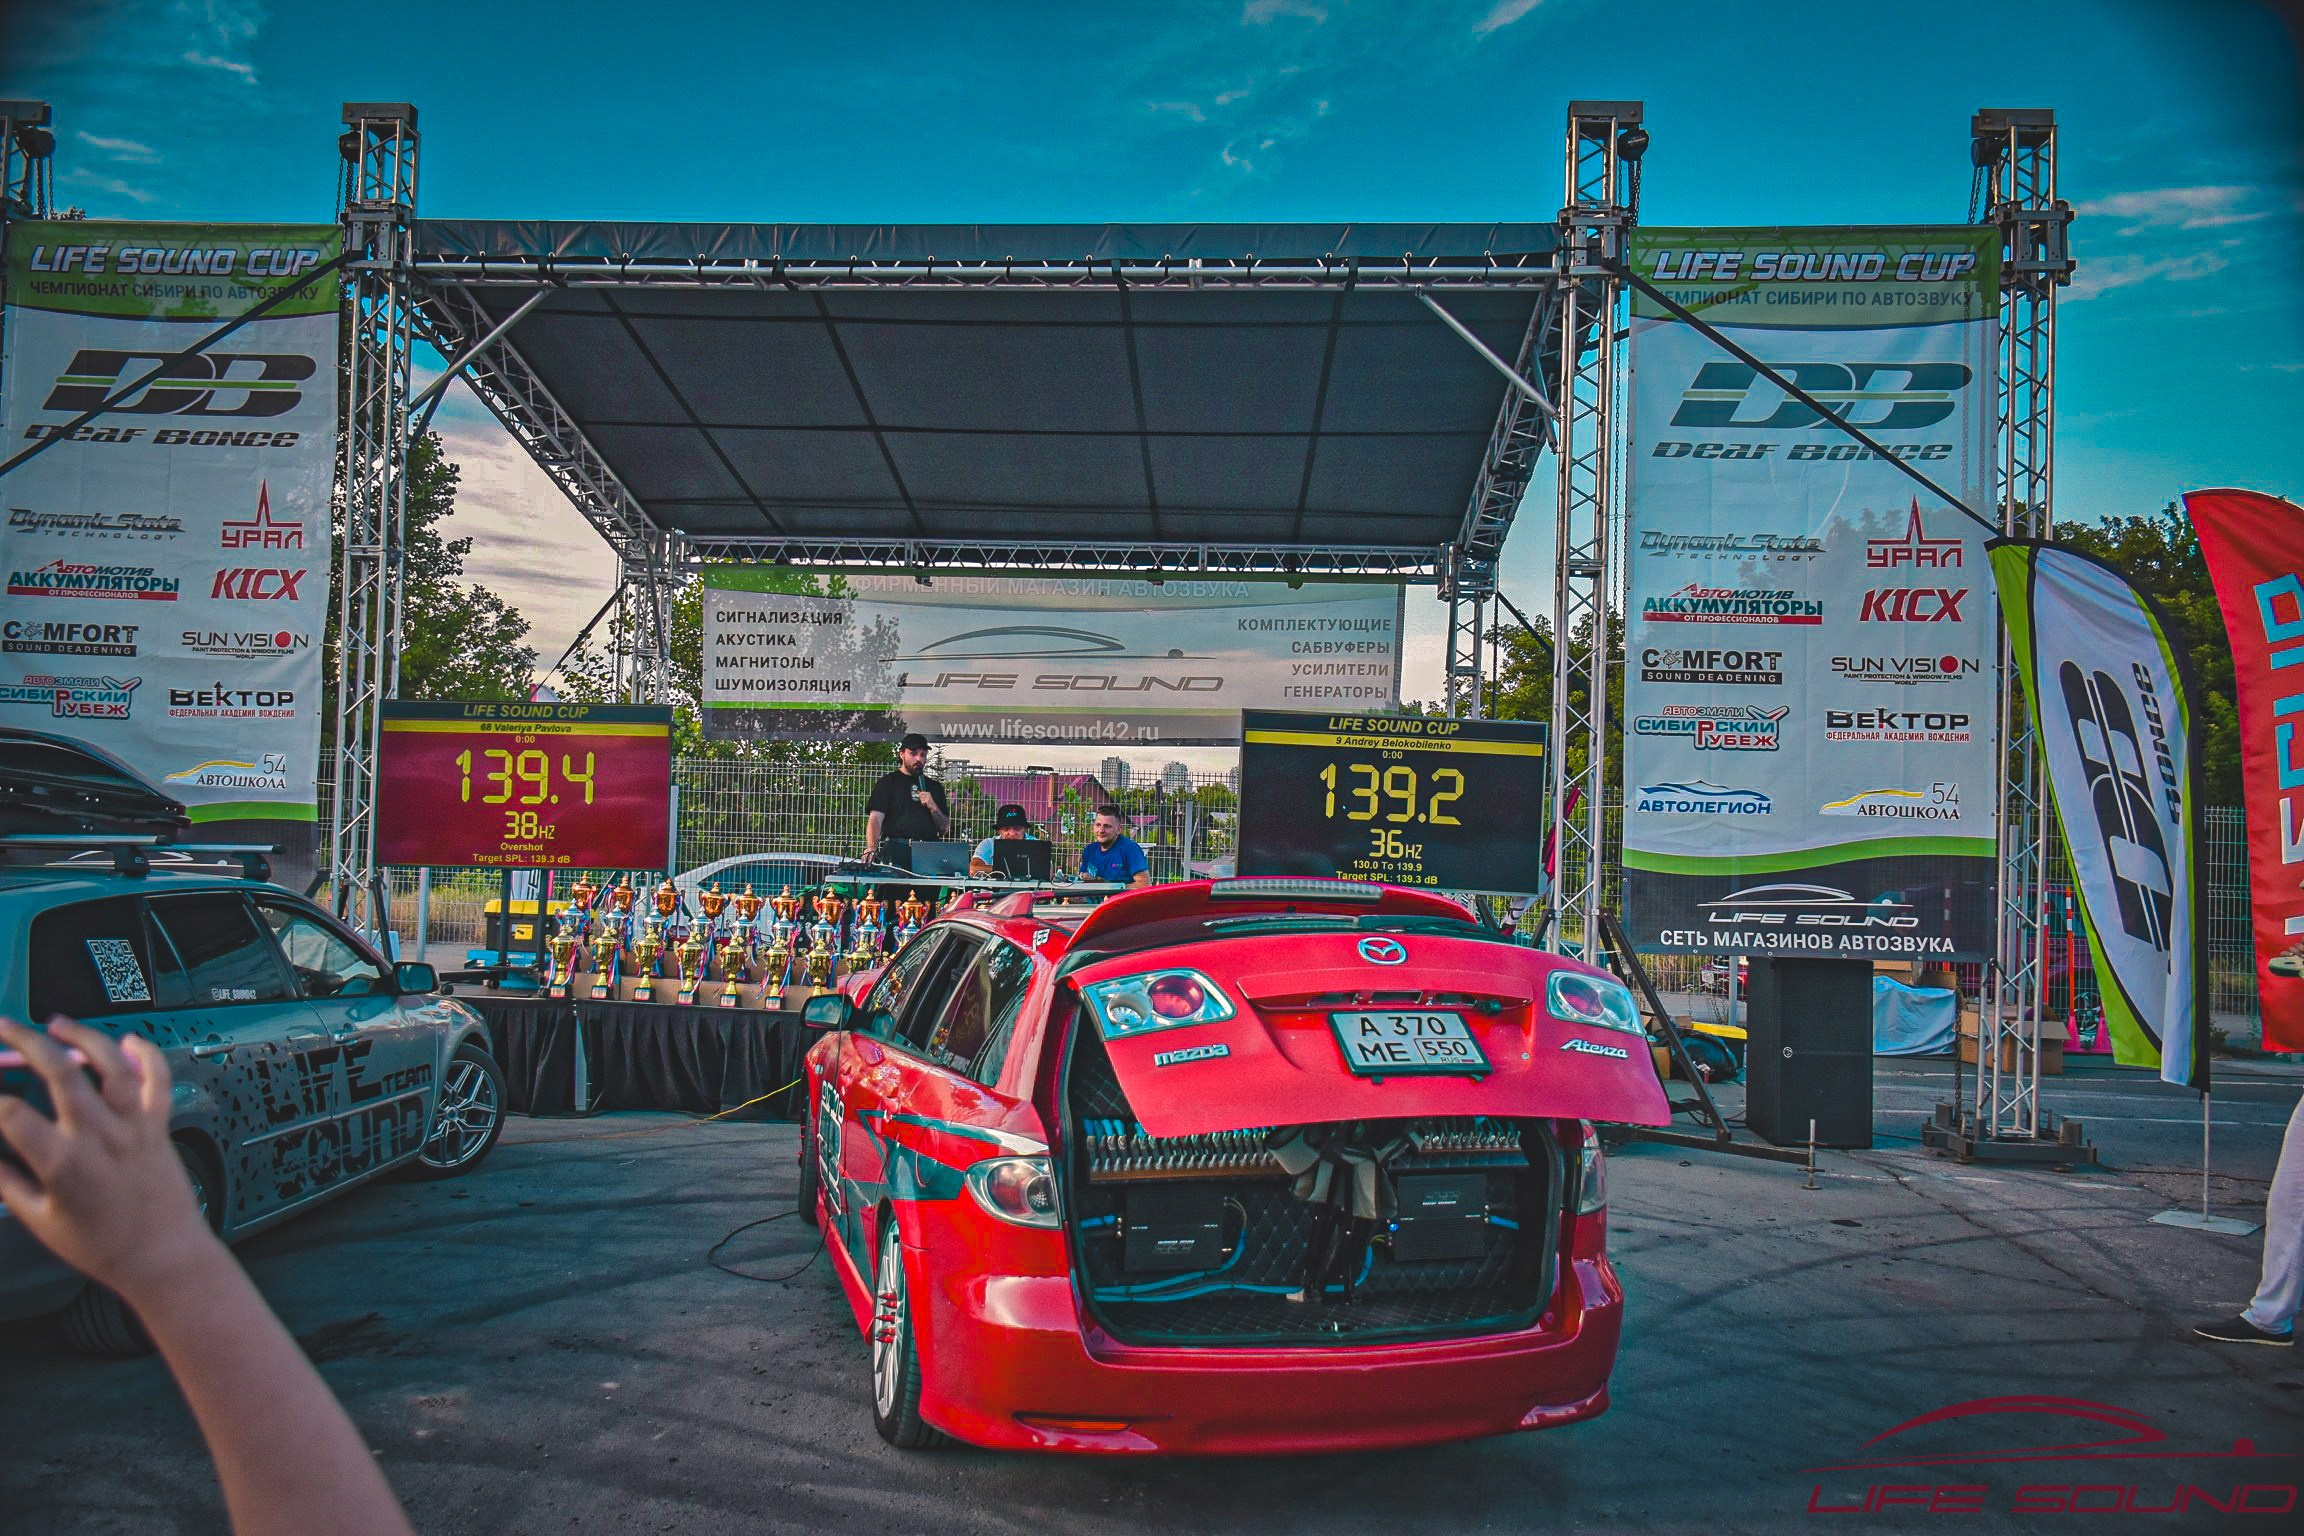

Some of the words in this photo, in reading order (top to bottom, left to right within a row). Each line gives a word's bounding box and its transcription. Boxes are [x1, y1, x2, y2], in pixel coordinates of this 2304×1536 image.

[30, 246, 110, 273] LIFE
[116, 248, 237, 276] SOUND
[246, 249, 320, 277] CUP
[1652, 251, 1743, 281] LIFE
[1749, 252, 1886, 281] SOUND
[1896, 252, 1977, 282] CUP
[30, 281, 128, 297] ЧЕМПИОНАТ
[133, 284, 196, 298] СИБИРИ
[201, 285, 223, 299] ПО
[228, 285, 319, 300] АВТОЗКУ
[1660, 291, 1761, 305] ЕМПИОНАТ
[1766, 291, 1836, 305] СИБИРИ
[1843, 291, 1866, 305] ПО
[9, 508, 112, 533] Dynamic
[117, 513, 186, 532] State
[44, 530, 176, 540] TECHNOLOGY
[222, 529, 303, 549] УРАЛ
[1640, 530, 1746, 557] Dynamic
[1751, 534, 1826, 553] State
[1676, 553, 1816, 561] TECHNOLOGY
[1867, 547, 1962, 568] УРАЛ
[8, 572, 179, 592] АККУМУЛЯТОРЫ
[210, 568, 307, 600] KICX
[1008, 579, 1111, 596] МАГАЗИН
[1118, 581, 1249, 598] АВТОЗВУКА
[49, 589, 60, 597] ОТ
[61, 590, 139, 599] ПРОФЕССИОНАЛОВ
[1643, 597, 1823, 615] АККУМУЛЯТОРЫ
[1859, 588, 1968, 622] KICX
[715, 611, 843, 626] СИГНАЛИЗАЦИЯ
[1238, 618, 1391, 633] КОМПЛЕКТУЮЩИЕ
[1697, 615, 1779, 623] ПРОФЕССИОНАЛОВ
[182, 631, 228, 646] SUN
[234, 631, 309, 648] VISION
[715, 633, 797, 647] АКУСТИКА
[8, 643, 51, 652] SOUND
[58, 645, 131, 655] DEADENING
[1292, 641, 1390, 655] САБВУФЕРЫ
[715, 656, 815, 670] МАГНИТОЛЫ
[1292, 663, 1389, 677] УСИЛИТЕЛИ
[1831, 657, 1884, 673] SUN
[1891, 656, 1979, 674] VISION
[23, 675, 100, 687] АВТОЭМАЛИ
[897, 673, 1019, 690] LIFE
[1031, 675, 1224, 692] SOUND
[1647, 672, 1691, 681] SOUND
[1698, 673, 1776, 682] DEADENING
[715, 679, 851, 693] ШУМОИЗОЛЯЦИЯ
[1283, 686, 1388, 699] ГЕНЕРАТОРЫ
[169, 709, 217, 717] ФЕДЕРАЛЬНАЯ
[221, 709, 255, 717] АКАДЕМИЯ
[259, 709, 294, 718] ВОЖДЕНИЯ
[463, 704, 495, 717] LIFE
[500, 705, 552, 718] SOUND
[557, 706, 589, 718] CUP
[1663, 705, 1744, 717] АВТОЭМАЛИ
[481, 723, 492, 732] 68
[494, 723, 532, 734] Valeriya
[534, 724, 572, 733] Pavlova
[940, 719, 1159, 742] www.lifesound42.ru
[1329, 717, 1362, 731] LIFE
[1366, 719, 1422, 734] SOUND
[1427, 721, 1460, 735] CUP
[516, 735, 535, 744] 0:00
[1336, 737, 1342, 745] 9
[1344, 737, 1379, 747] Andrey
[1382, 739, 1452, 750] Belokobilenko
[1826, 731, 1880, 740] ФЕДЕРАЛЬНАЯ
[1884, 732, 1924, 741] АКАДЕМИЯ
[1928, 732, 1969, 742] ВОЖДЕНИЯ
[1382, 750, 1403, 759] 0:00
[264, 754, 286, 774] 54
[196, 774, 286, 789] АВТОШКОЛА
[455, 749, 595, 805] 139.4
[1320, 762, 1464, 825] 139.2
[1932, 782, 1960, 805] 54
[1637, 800, 1771, 814] АВТОЛЕГИОН
[1857, 804, 1960, 820] АВТОШКОЛА
[501, 842, 543, 851] Overshot
[473, 853, 502, 864] Target
[505, 854, 528, 863] SPL:
[531, 854, 555, 864] 139.3
[557, 855, 571, 864] dB
[1353, 860, 1379, 869] 130.0
[1382, 861, 1394, 870] To
[1397, 862, 1422, 871] 139.9
[1336, 871, 1367, 881] Target
[1370, 873, 1393, 882] SPL:
[1396, 874, 1421, 883] 139.3
[1424, 876, 1438, 884] dB
[1708, 912, 1787, 924] LIFE
[1795, 914, 1919, 928] SOUND
[1660, 929, 1708, 947] СЕТЬ
[1713, 931, 1833, 950] МАГАЗИНОВ
[1838, 935, 1955, 953] АВТОЗВУКА
[1387, 1016, 1446, 1036] 370
[1421, 1041, 1468, 1056] 550
[1560, 1039, 1629, 1059] Atenza
[381, 1063, 433, 1095] TEAM
